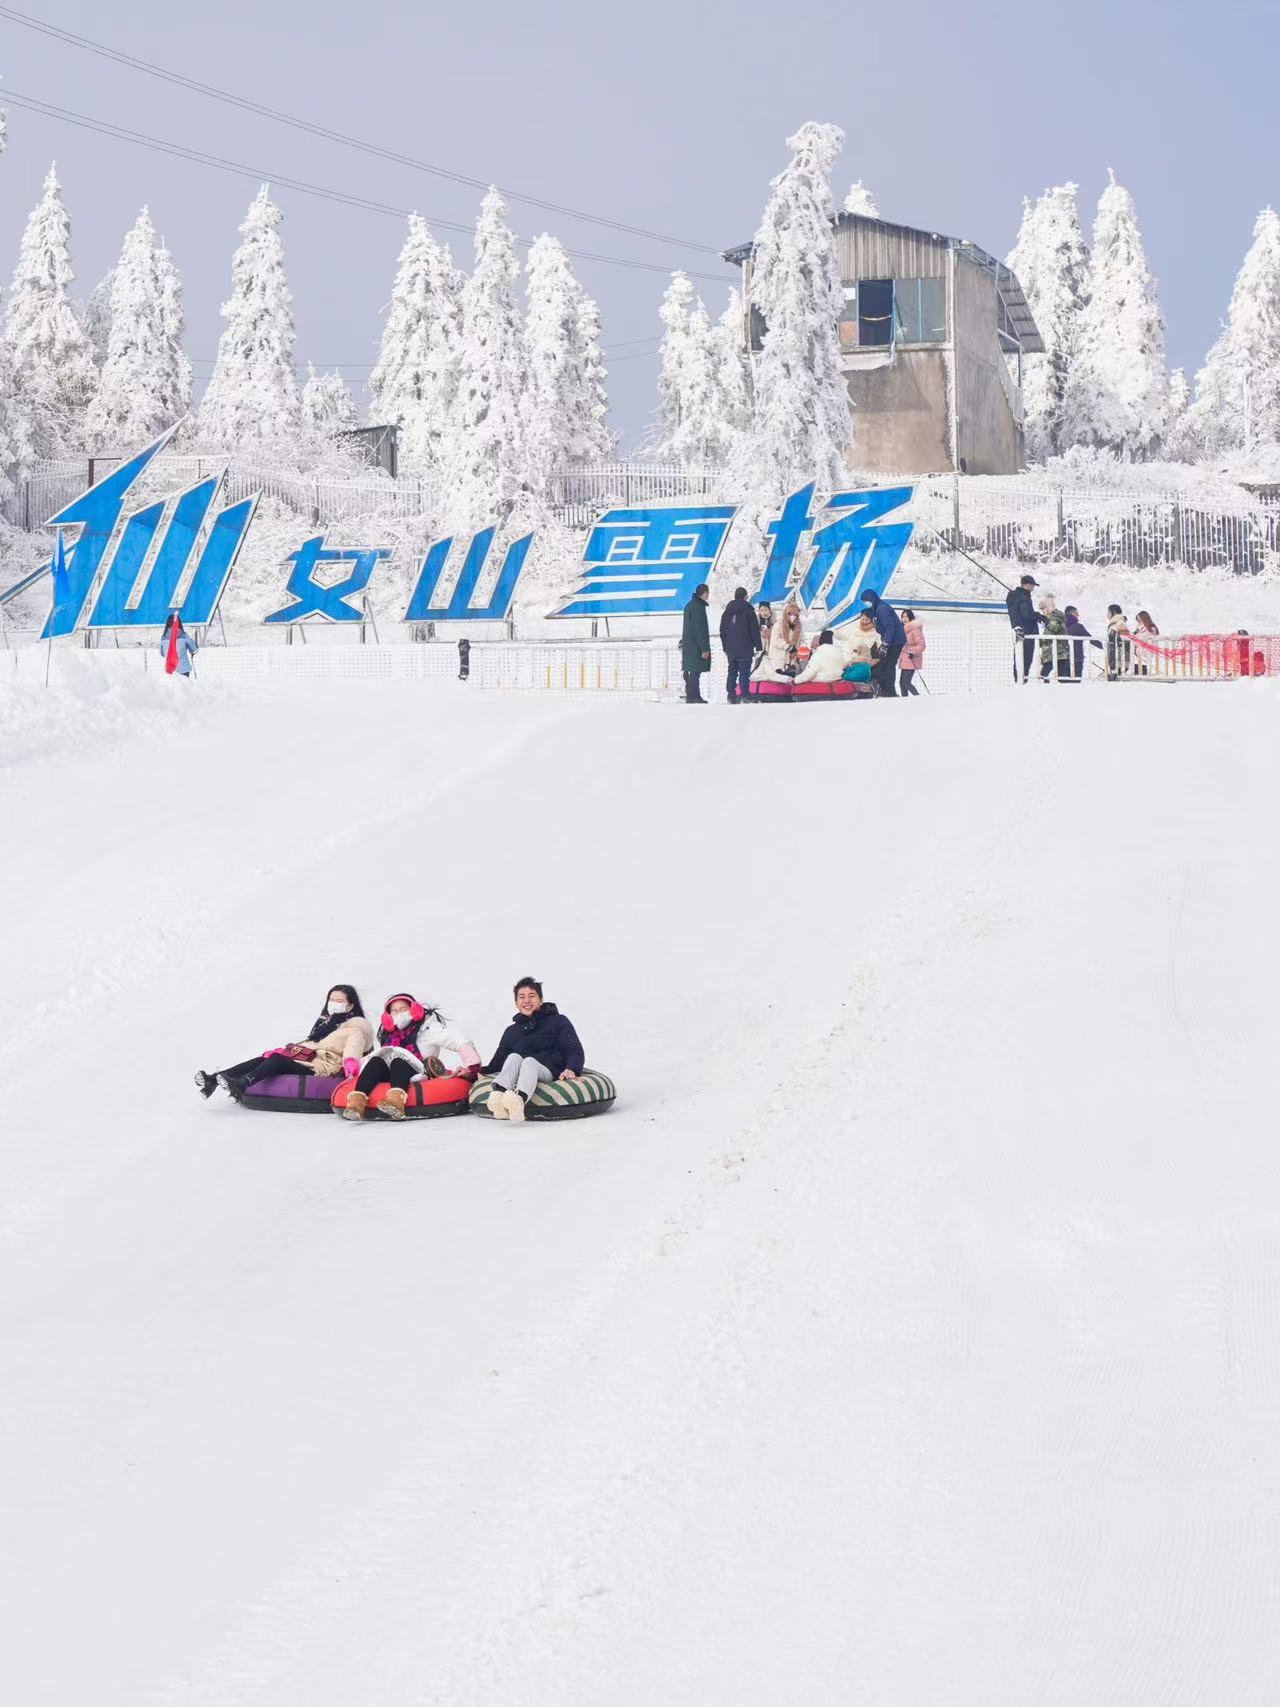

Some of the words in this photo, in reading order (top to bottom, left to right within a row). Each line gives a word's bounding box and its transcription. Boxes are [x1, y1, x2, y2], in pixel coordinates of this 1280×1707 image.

[40, 416, 918, 639] 仙女山雪场
